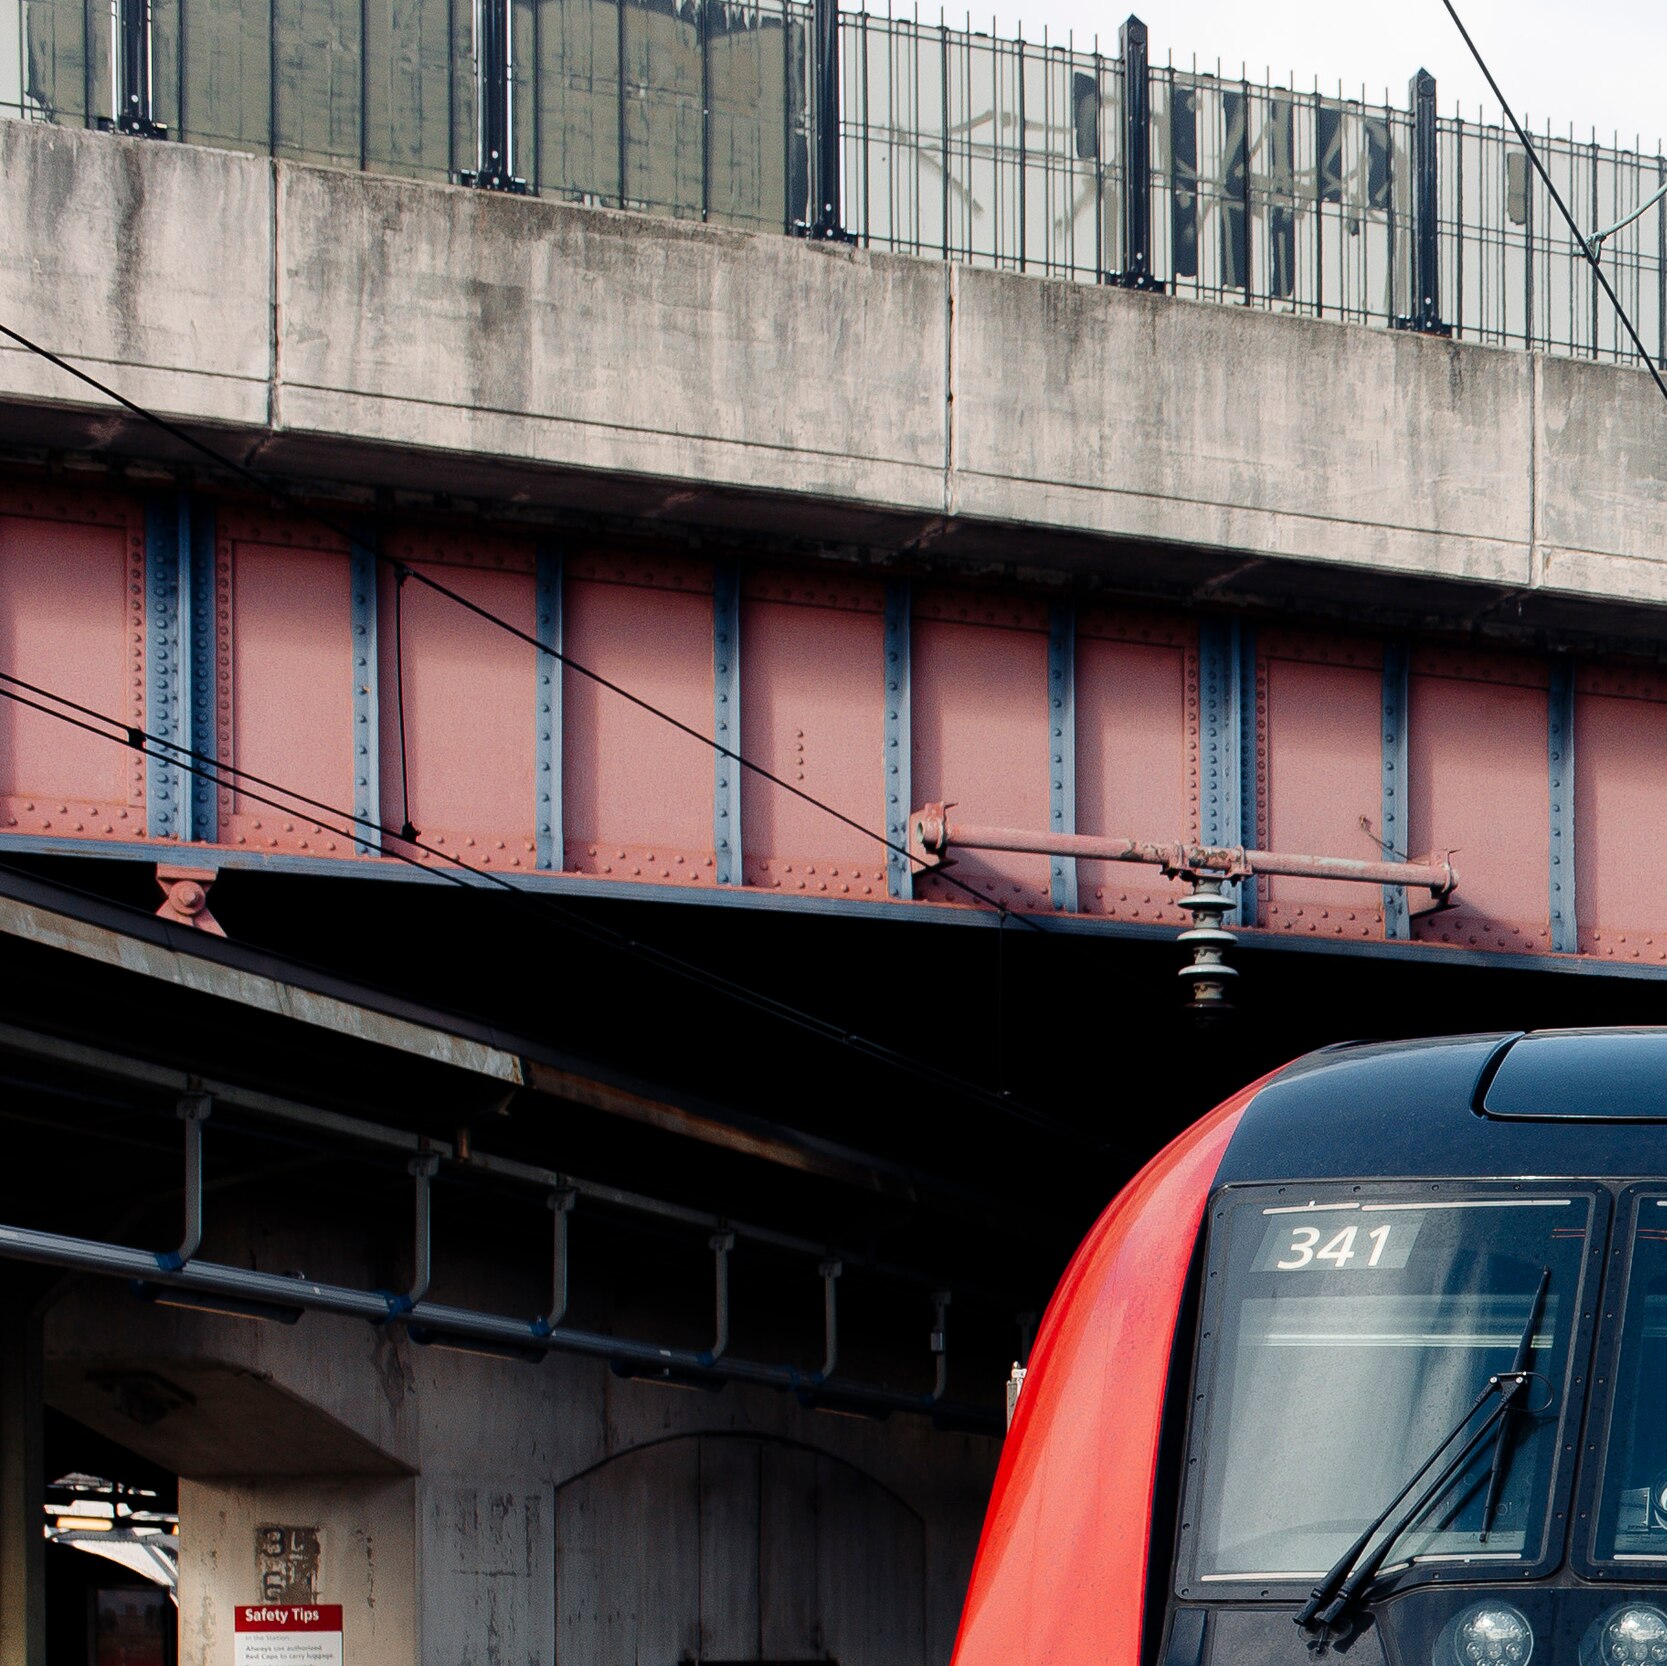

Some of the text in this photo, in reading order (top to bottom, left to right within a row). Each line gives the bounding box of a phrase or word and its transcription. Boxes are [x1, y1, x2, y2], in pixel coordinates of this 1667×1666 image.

[1276, 1224, 1392, 1270] 341
[245, 1608, 319, 1624] Safety Tips
